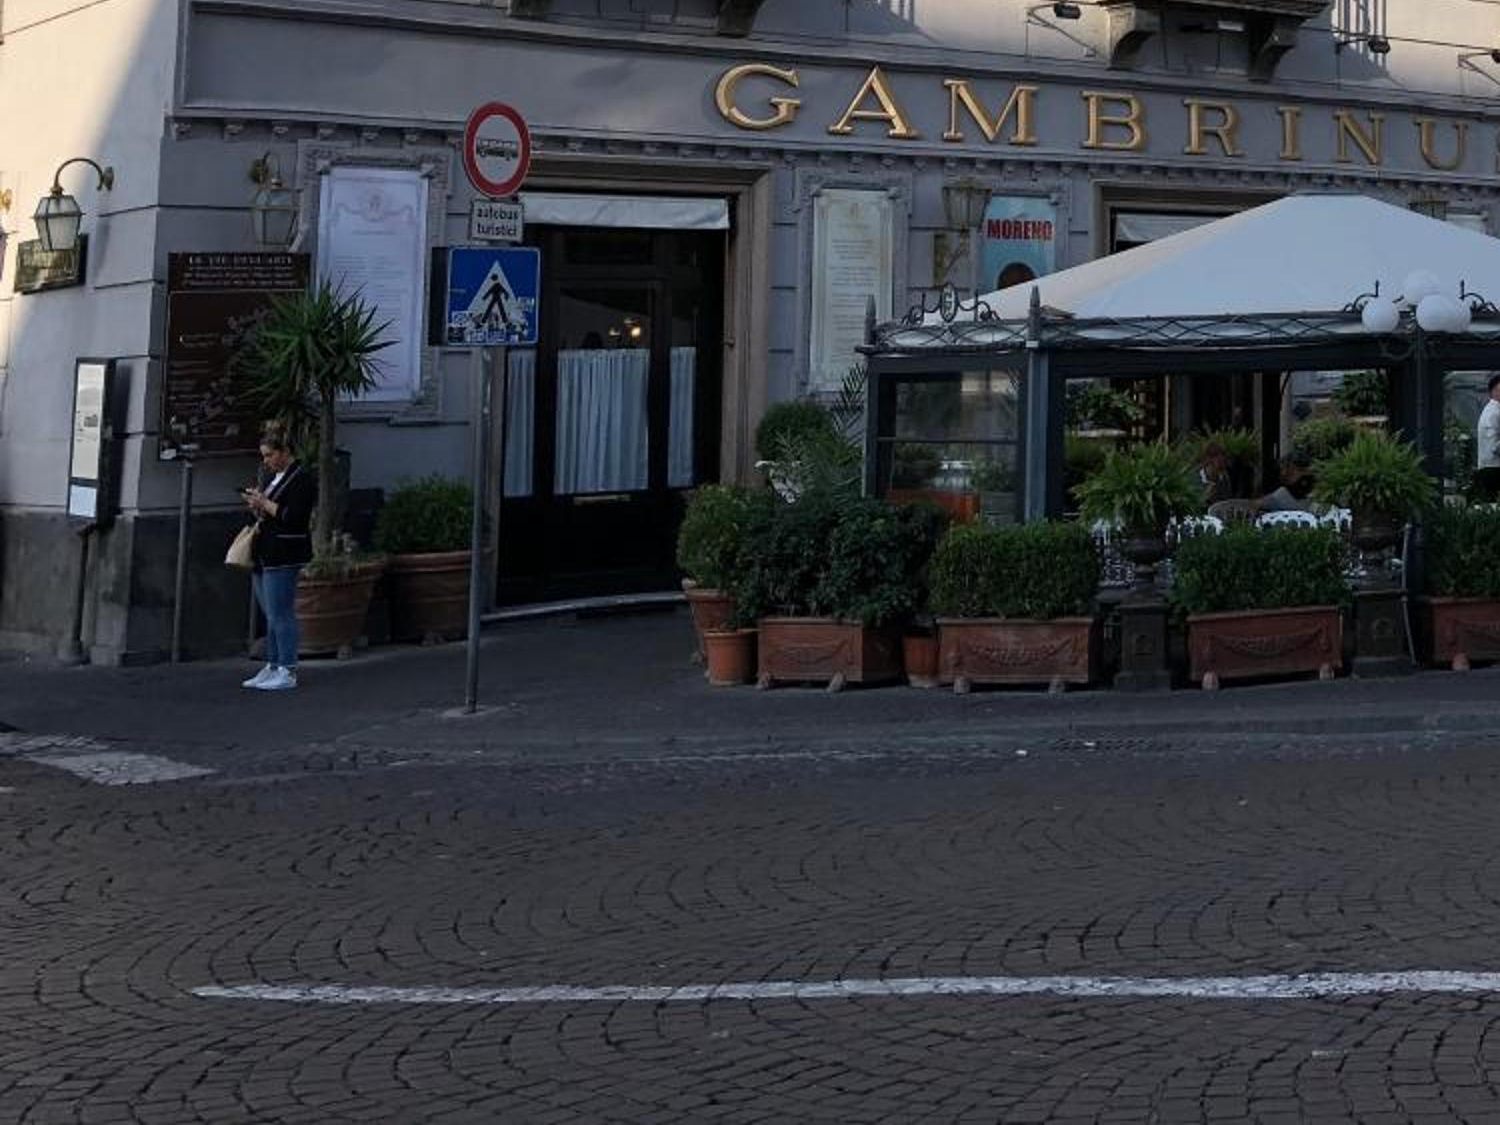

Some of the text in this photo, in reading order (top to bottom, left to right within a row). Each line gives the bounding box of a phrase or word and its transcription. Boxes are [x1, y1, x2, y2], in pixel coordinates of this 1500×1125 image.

[477, 205, 519, 220] autobus
[477, 222, 517, 236] turistici
[986, 218, 1055, 241] MORENO
